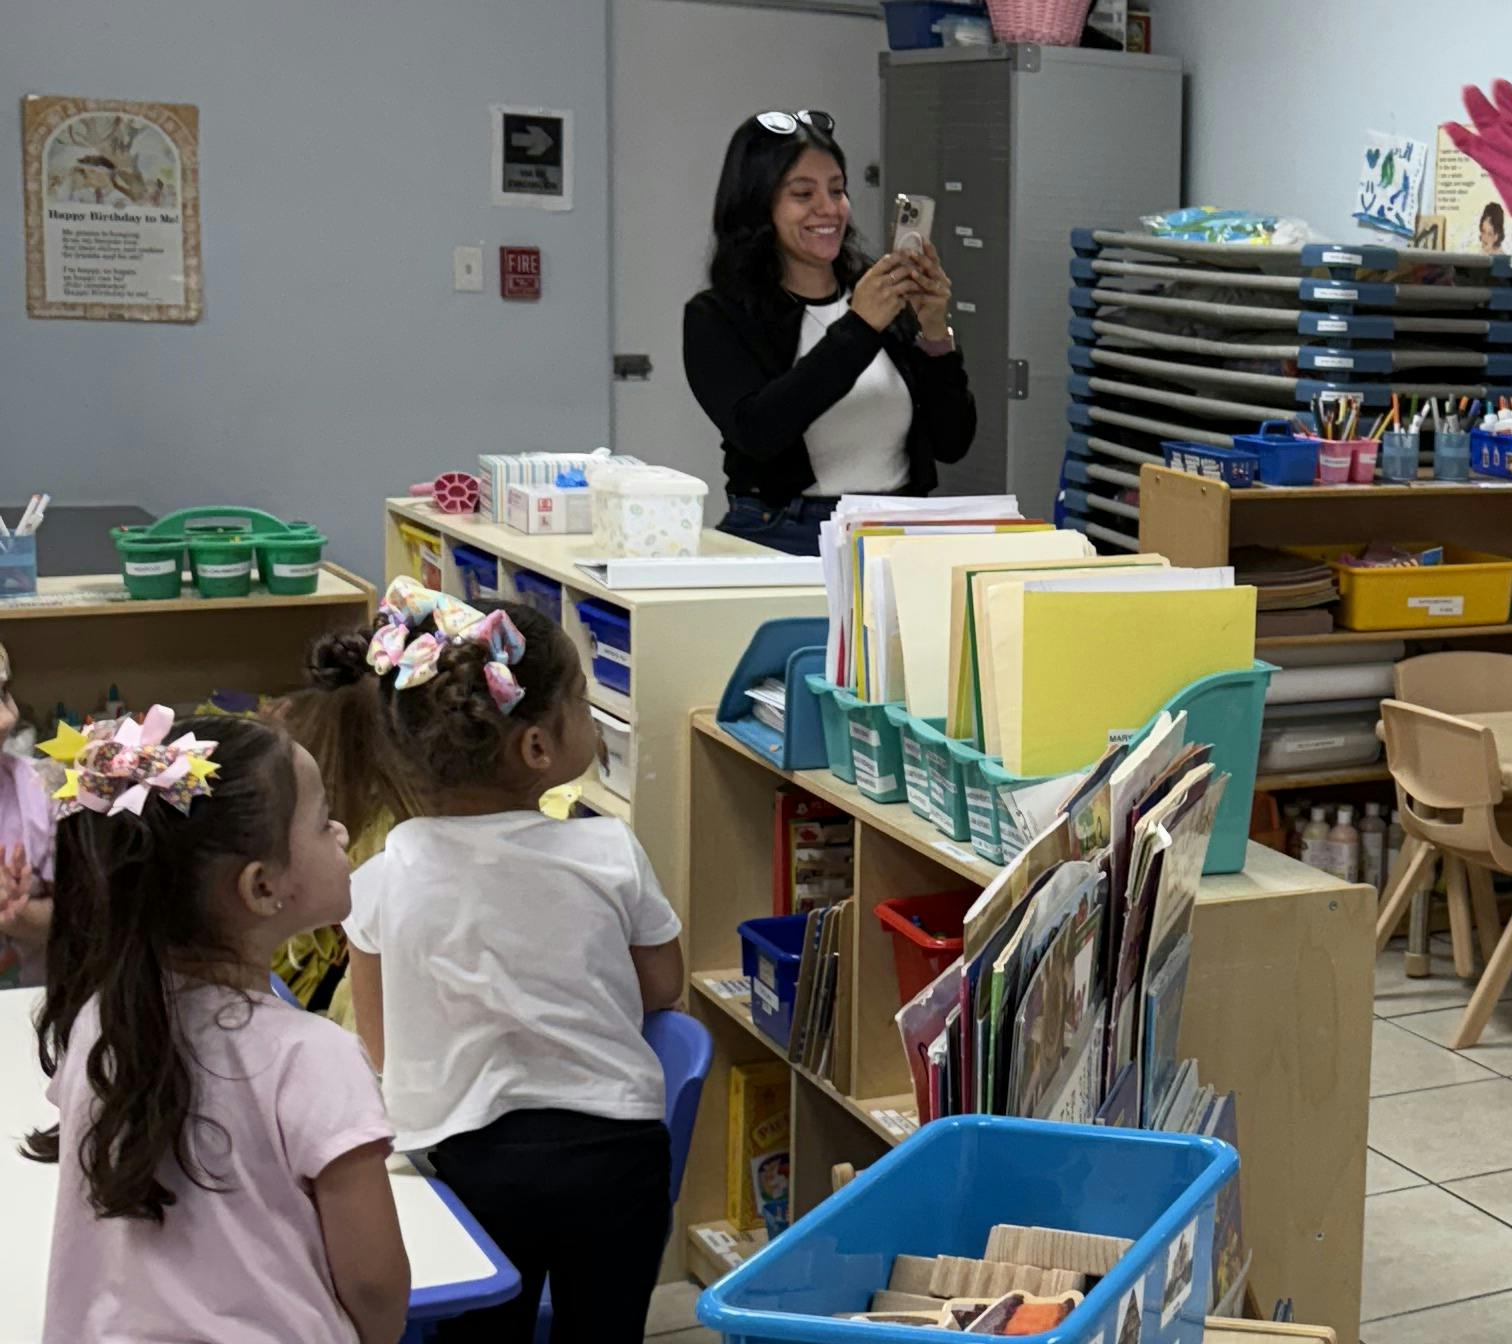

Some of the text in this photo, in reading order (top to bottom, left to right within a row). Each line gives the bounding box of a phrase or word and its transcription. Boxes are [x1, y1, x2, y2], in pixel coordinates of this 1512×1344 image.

[49, 209, 179, 224] Happy Birthday to Me!
[508, 254, 539, 274] FIRE
